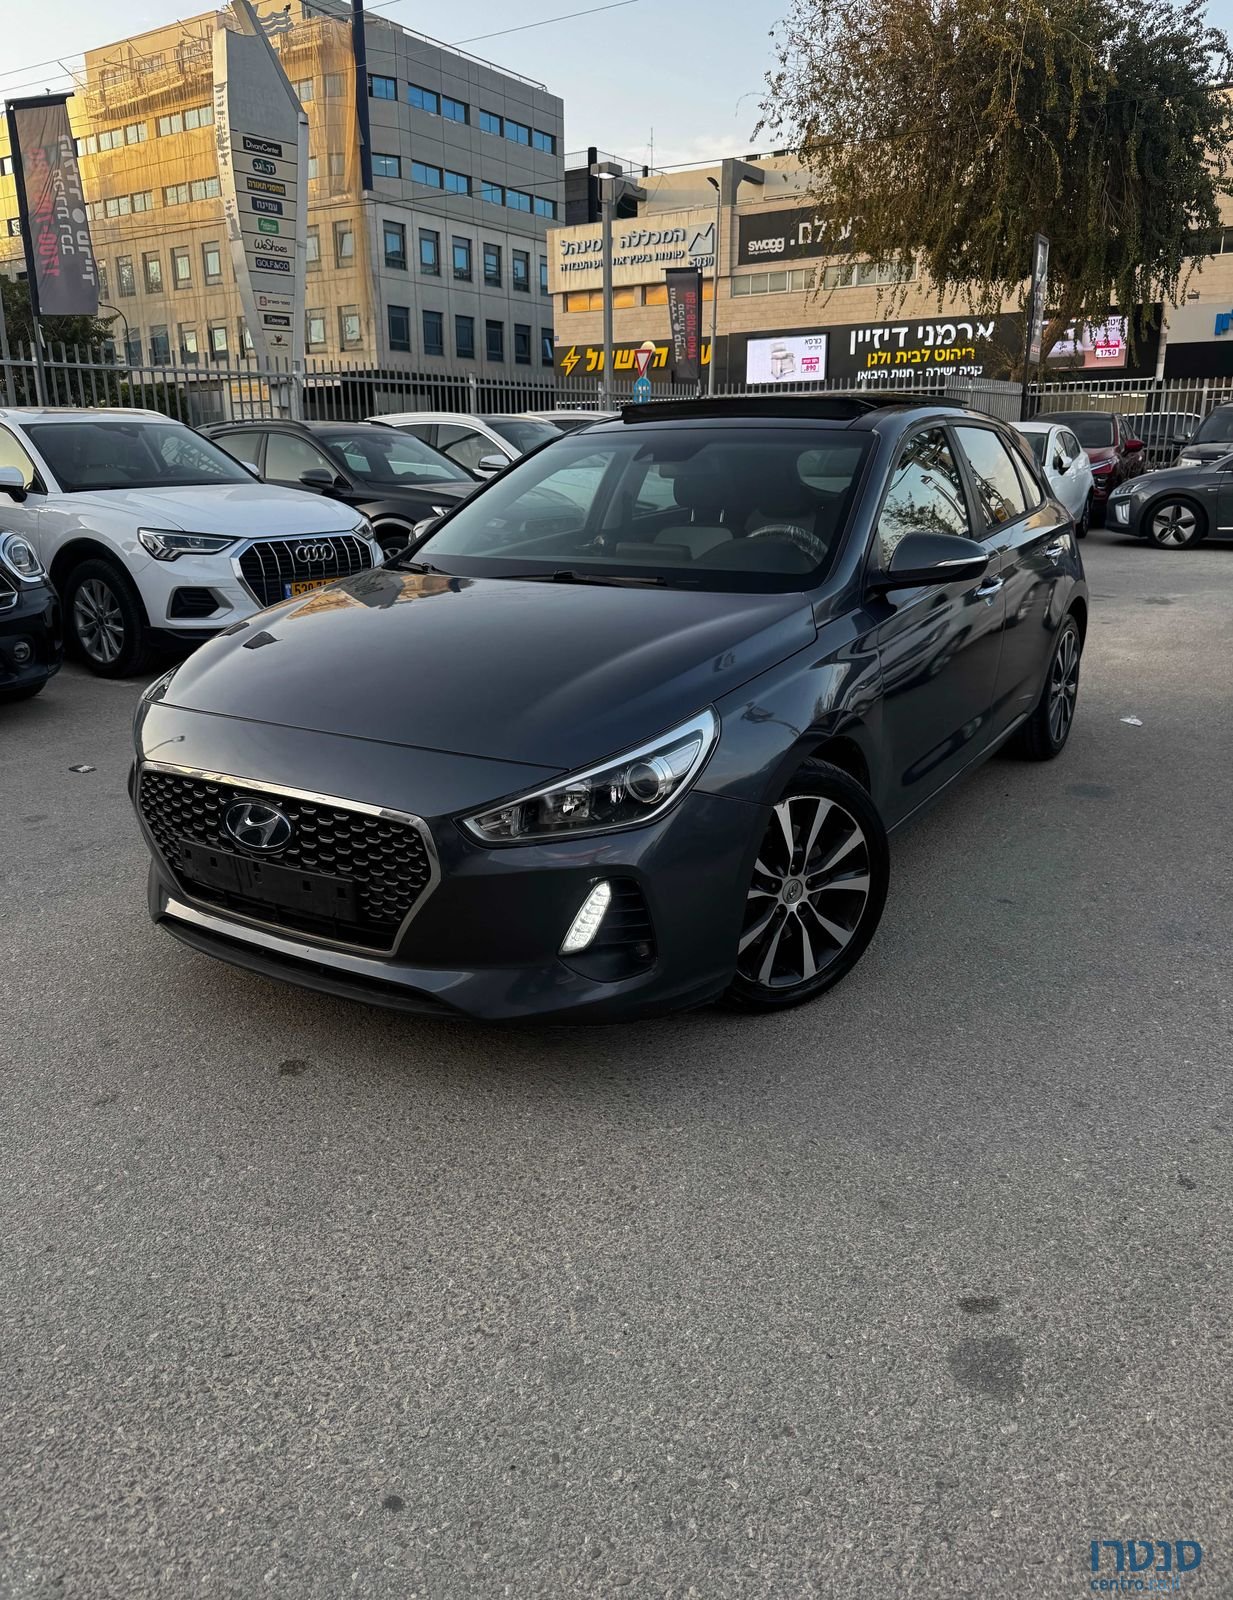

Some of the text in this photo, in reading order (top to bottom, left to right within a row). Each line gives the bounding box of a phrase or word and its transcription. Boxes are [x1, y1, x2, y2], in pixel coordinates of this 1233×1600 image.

[247, 180, 267, 190] תאורה
[256, 200, 278, 212] עמינח
[254, 238, 288, 253] WeShoes
[560, 228, 686, 256] המכללה מינהל
[748, 237, 785, 253] swagg
[256, 259, 289, 270] GOLF&CO
[560, 260, 592, 272] העבודה
[849, 321, 995, 355] ארמני דיזיין
[867, 347, 976, 367] ריהוט לבית ולגן
[1100, 348, 1117, 356] 1750
[857, 369, 888, 382] היבואן
[890, 368, 914, 379] חנות
[926, 366, 956, 377] ישירה
[958, 365, 983, 377] קניה
